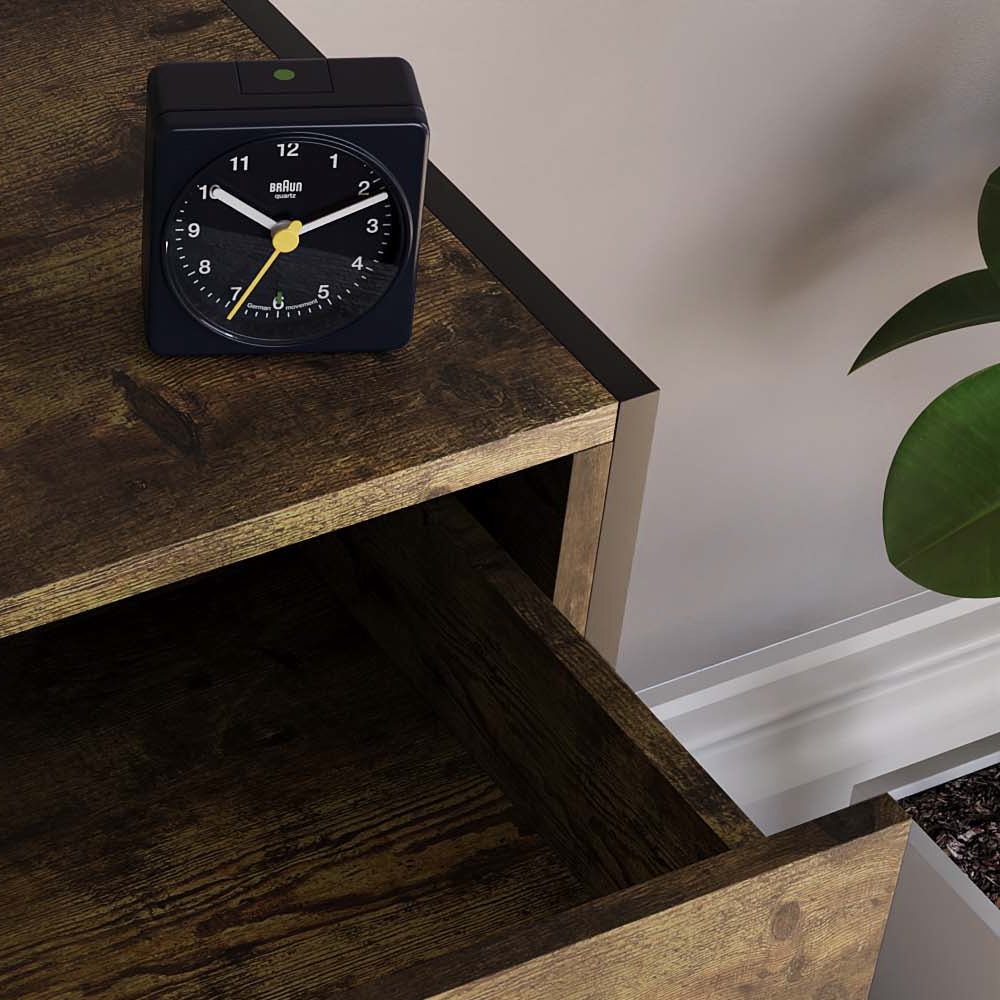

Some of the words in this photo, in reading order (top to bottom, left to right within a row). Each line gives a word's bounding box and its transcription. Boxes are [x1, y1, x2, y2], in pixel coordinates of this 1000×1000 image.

[276, 143, 300, 157] 12
[229, 155, 249, 171] 11
[329, 153, 338, 169] 1
[269, 180, 303, 193] BRAUN
[358, 181, 371, 196] 2
[187, 223, 201, 239] 9
[366, 218, 379, 234] 3
[198, 260, 211, 275] 8
[351, 256, 364, 271] 4
[230, 287, 243, 302] 7
[317, 284, 330, 299] 5
